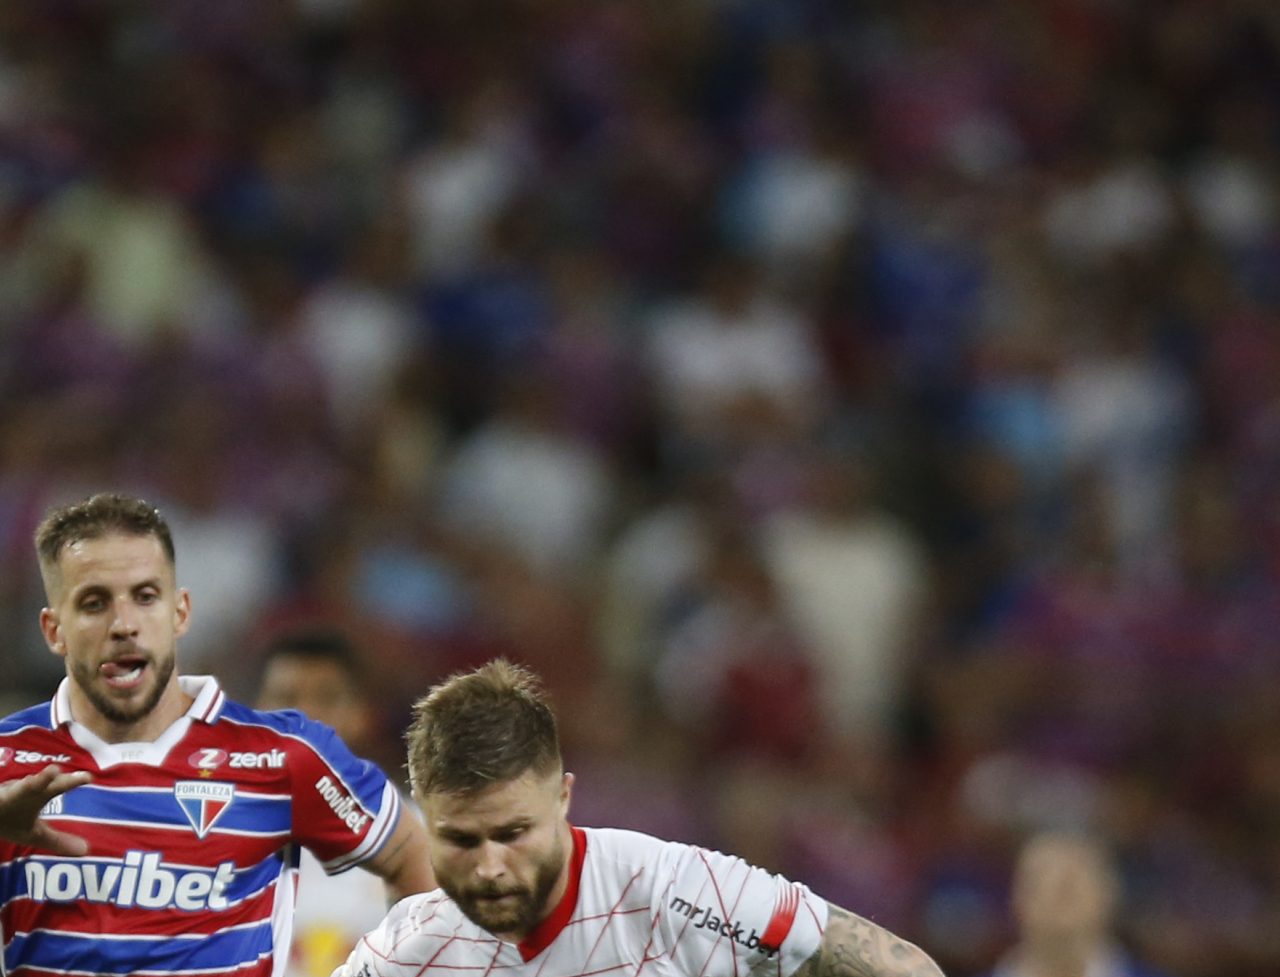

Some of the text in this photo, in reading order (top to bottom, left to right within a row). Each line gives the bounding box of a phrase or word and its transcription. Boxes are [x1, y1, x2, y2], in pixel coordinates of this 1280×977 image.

[229, 749, 286, 768] zenir
[176, 783, 231, 797] FORTALEZA
[315, 775, 369, 835] novibet
[24, 851, 235, 912] novibet
